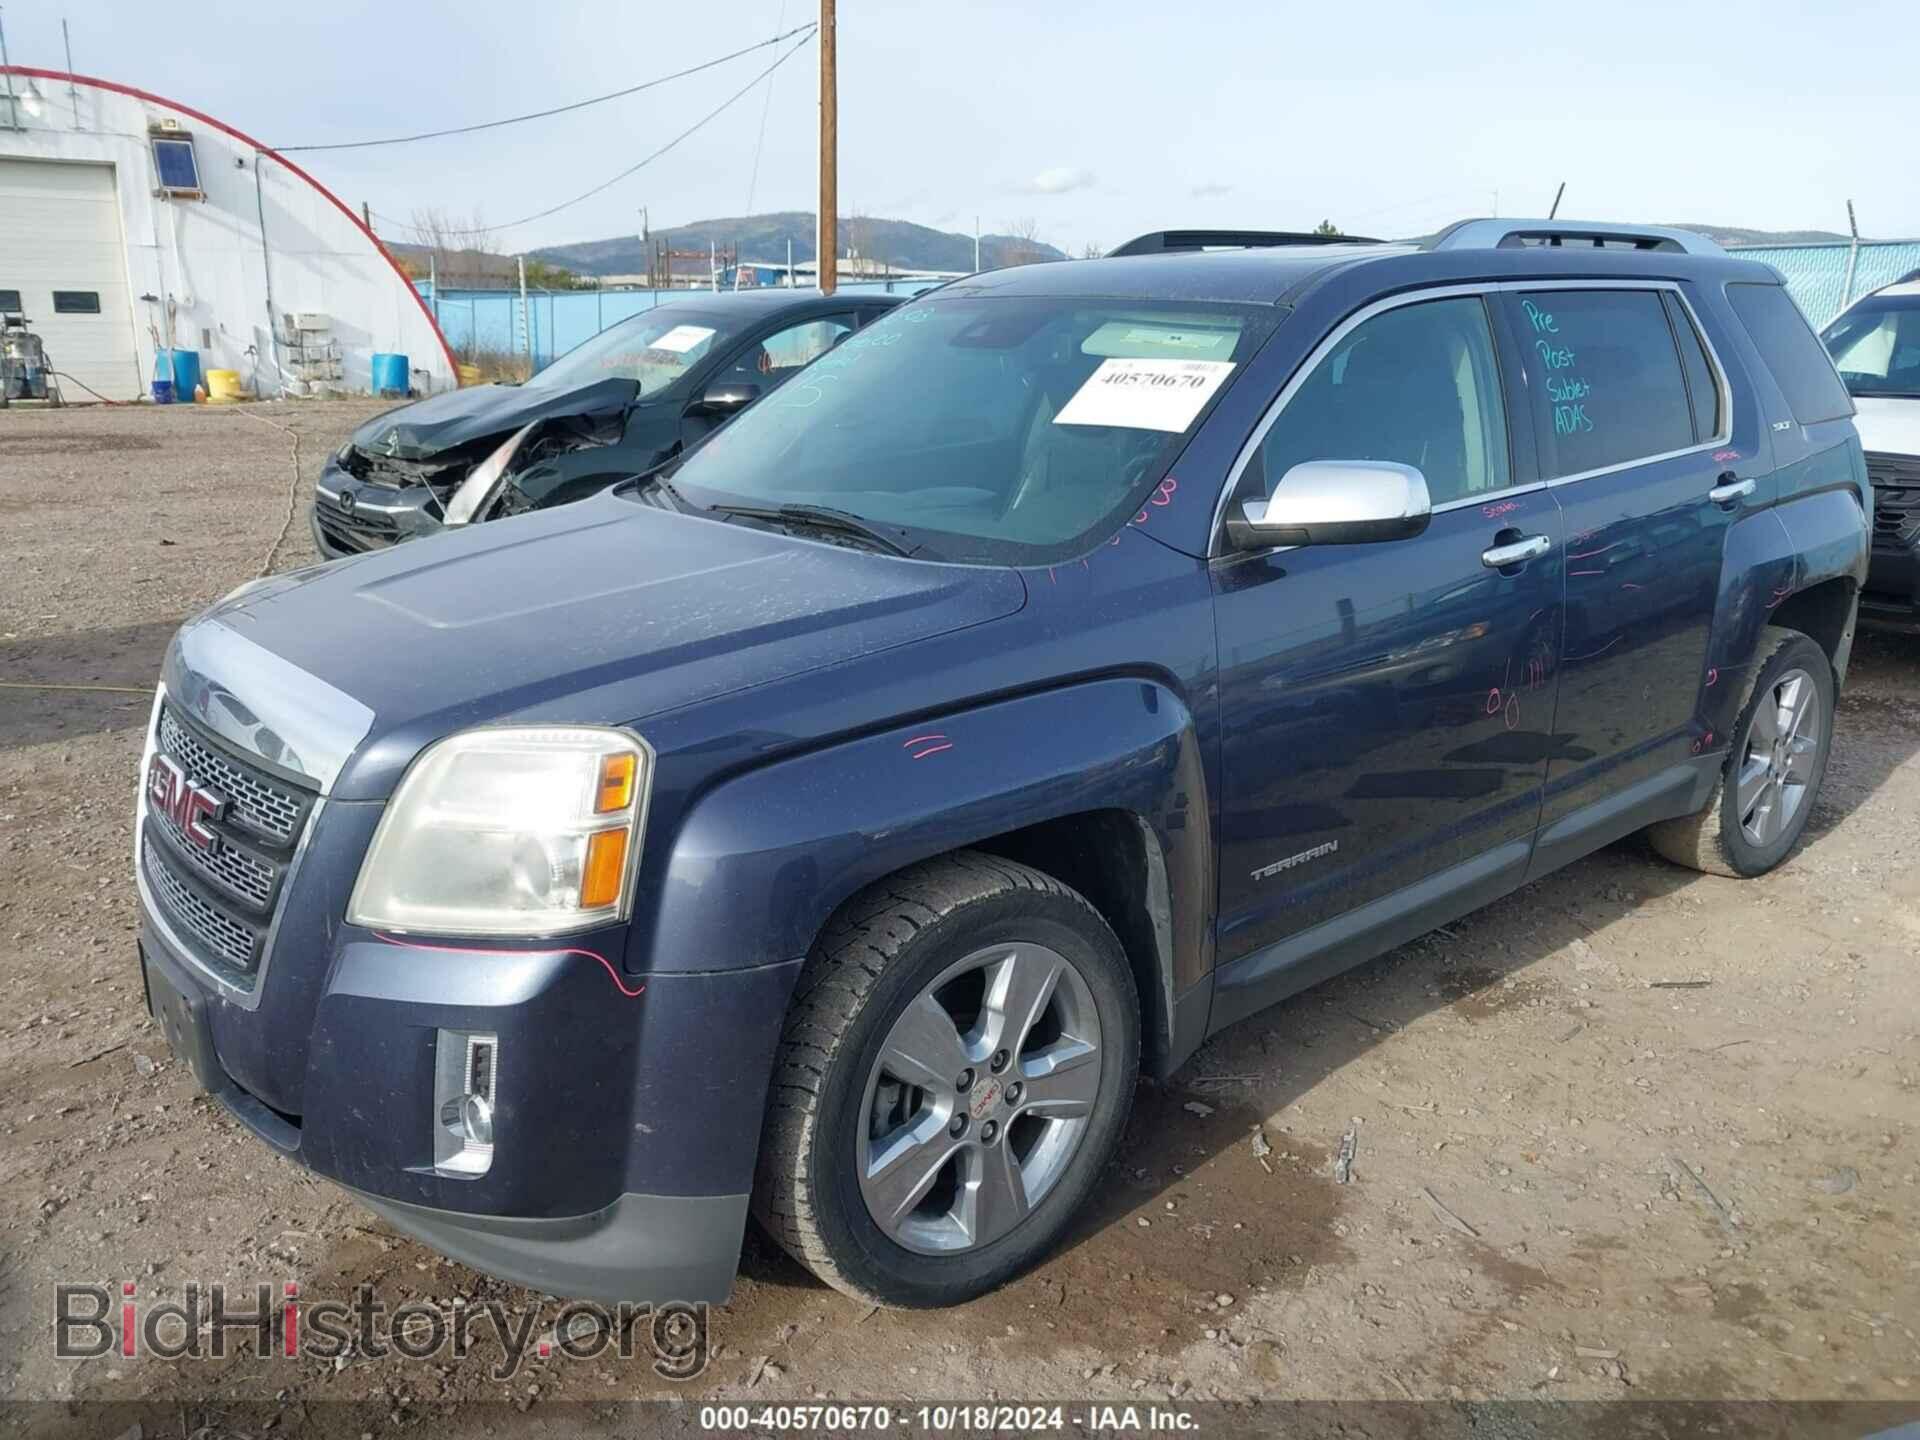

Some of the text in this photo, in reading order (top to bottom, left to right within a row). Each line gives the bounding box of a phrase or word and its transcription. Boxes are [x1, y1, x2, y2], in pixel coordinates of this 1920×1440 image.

[1522, 299, 1559, 332] Pre
[1536, 340, 1576, 369] Post
[1101, 371, 1207, 389] 40570670
[1554, 404, 1594, 433] ADAS
[150, 754, 224, 851] GMC
[1250, 839, 1339, 881] TERRAIN
